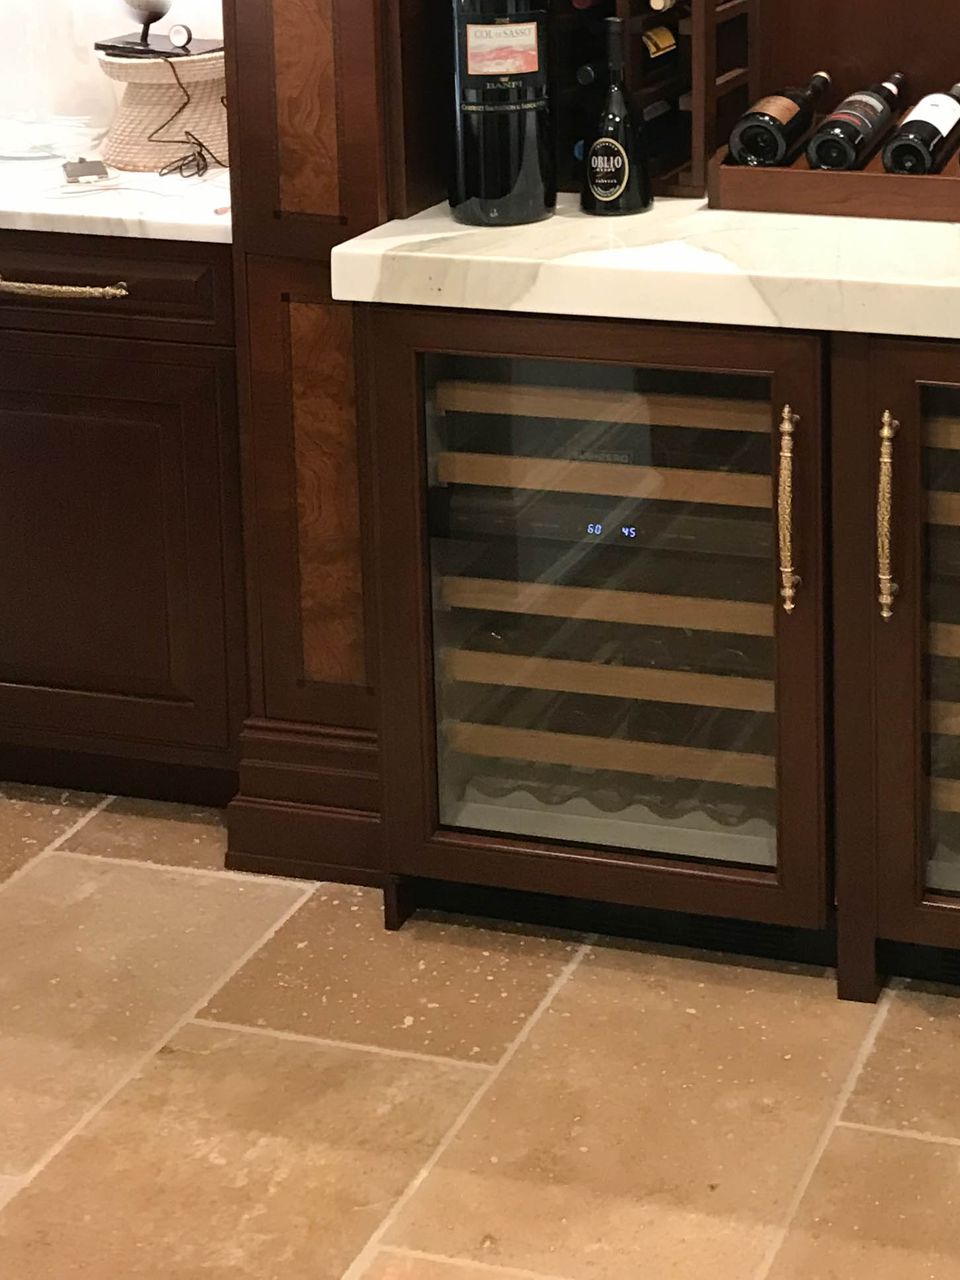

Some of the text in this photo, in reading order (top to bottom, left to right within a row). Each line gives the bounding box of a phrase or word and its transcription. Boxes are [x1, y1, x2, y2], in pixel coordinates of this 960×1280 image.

[591, 155, 622, 168] OBLIO
[587, 523, 636, 538] 60 45
